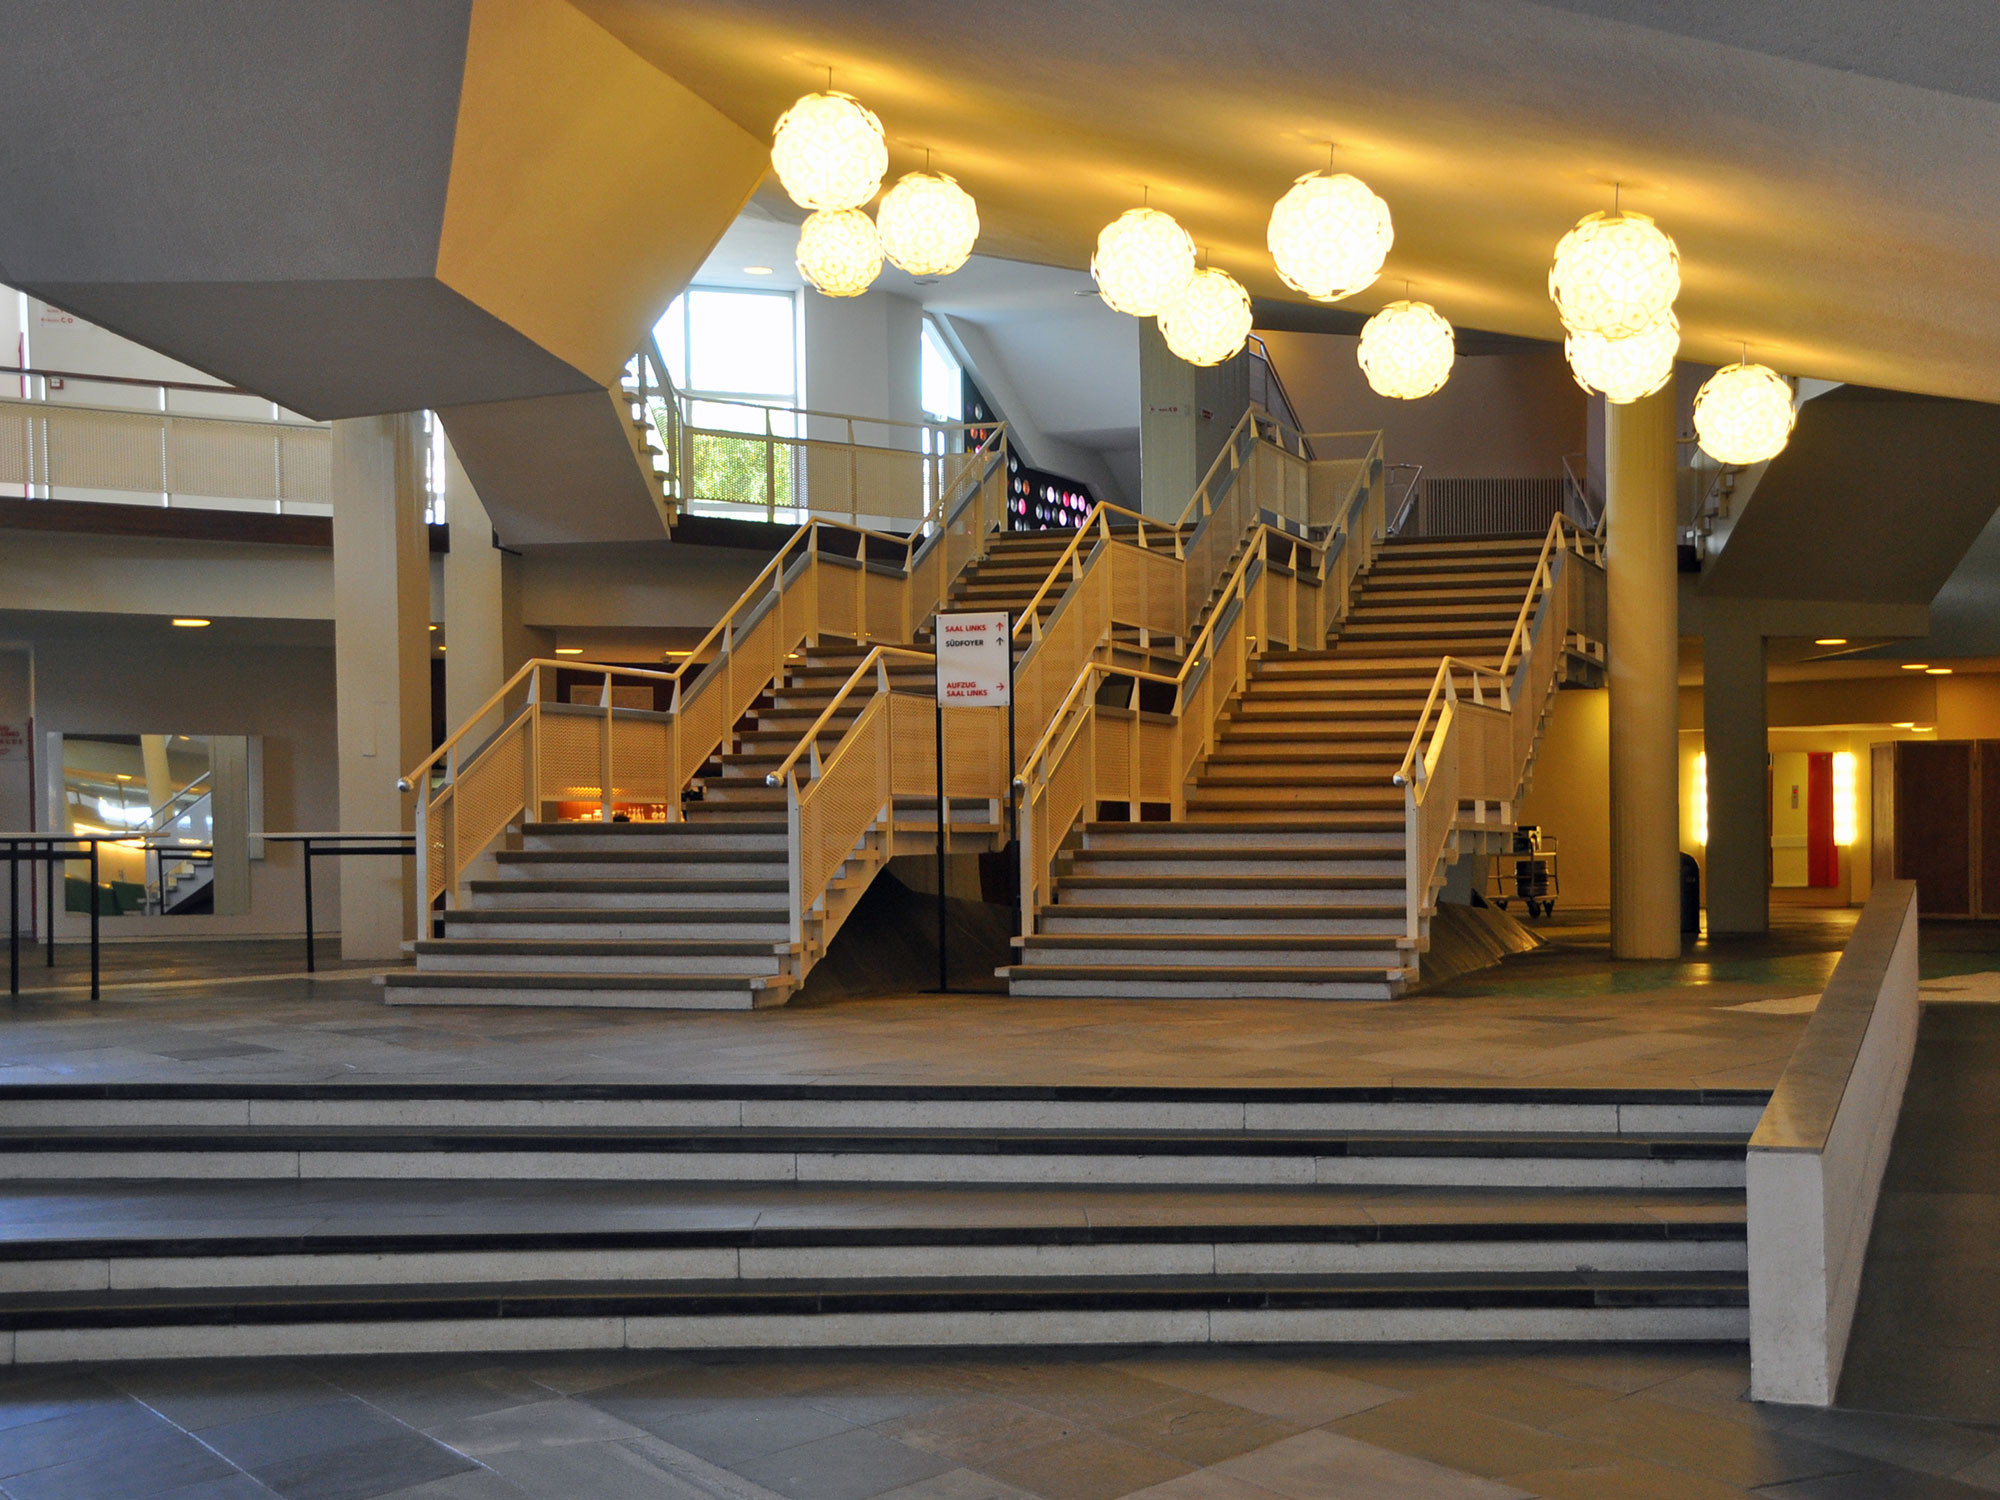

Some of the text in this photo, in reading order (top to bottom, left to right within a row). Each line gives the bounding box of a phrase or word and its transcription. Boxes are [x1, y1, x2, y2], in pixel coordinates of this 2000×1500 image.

[965, 624, 986, 632] LINKS
[945, 639, 984, 647] SÜDFOYER
[946, 681, 976, 689] AUFZUG
[967, 689, 988, 697] LINKS
